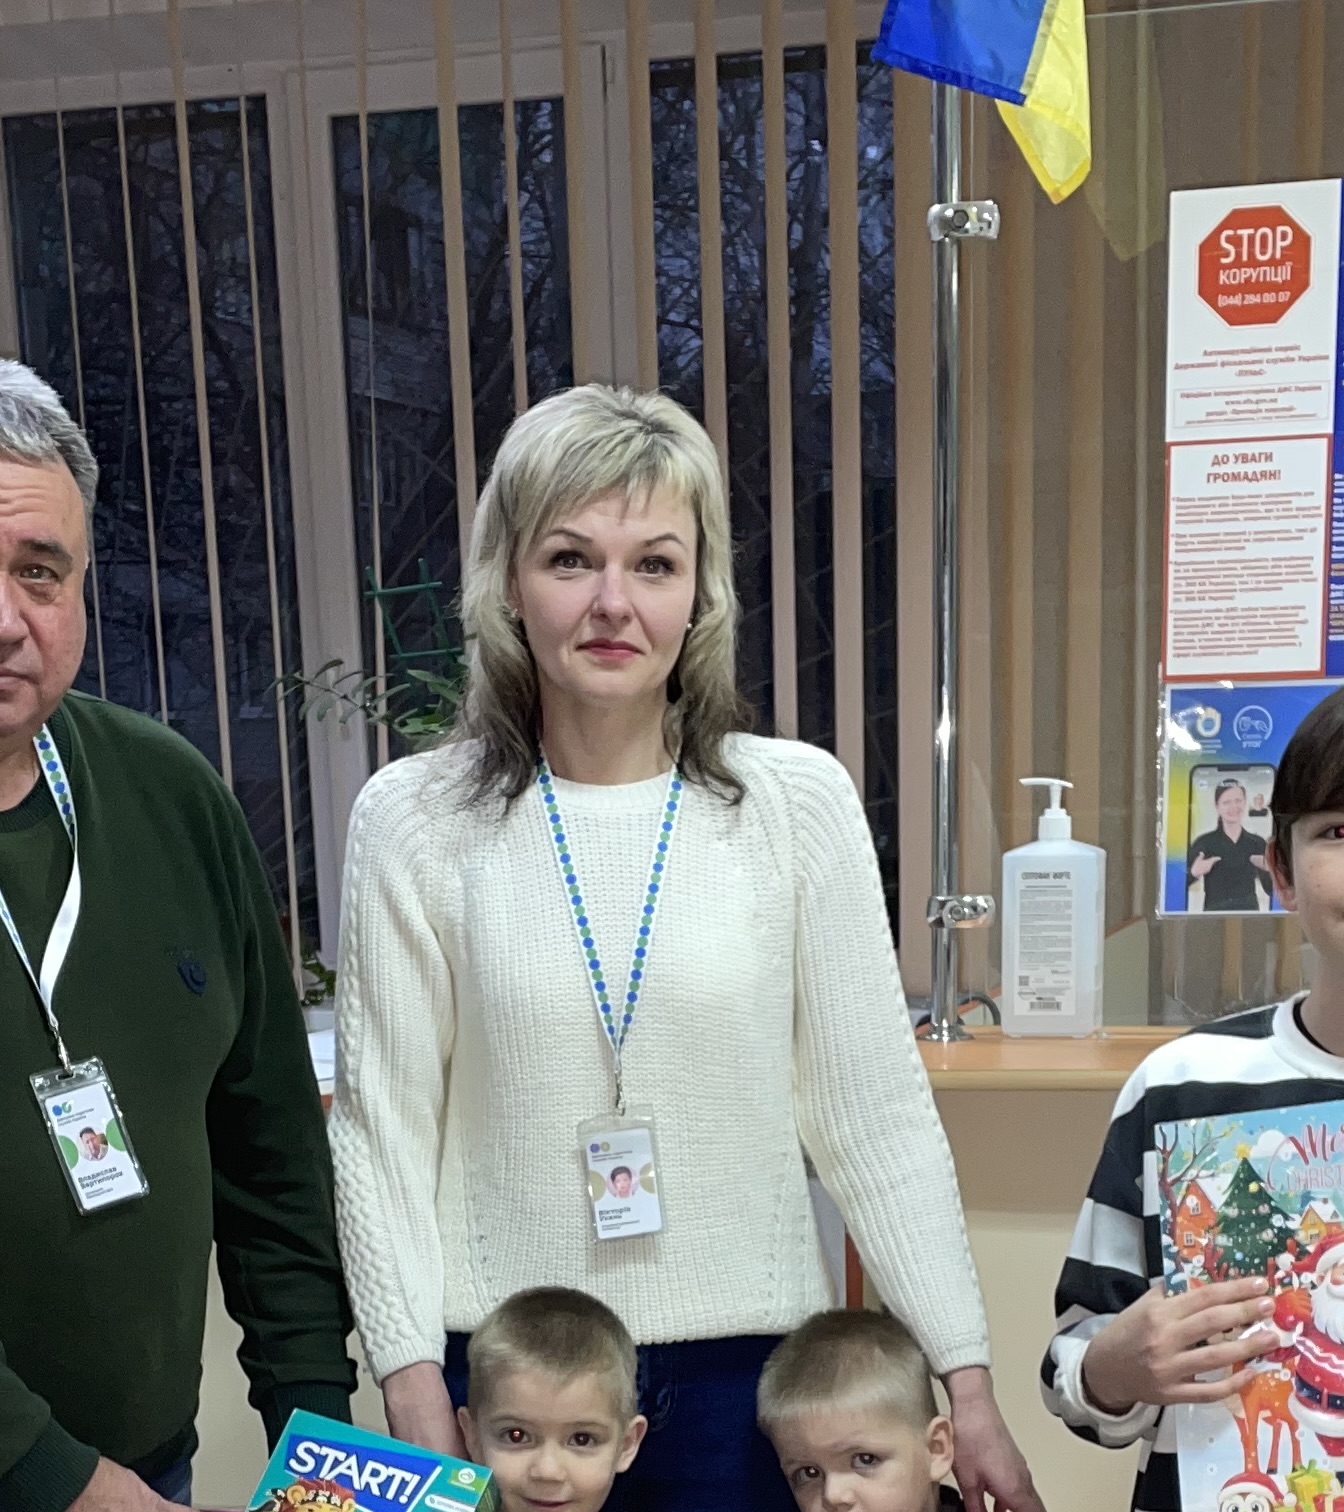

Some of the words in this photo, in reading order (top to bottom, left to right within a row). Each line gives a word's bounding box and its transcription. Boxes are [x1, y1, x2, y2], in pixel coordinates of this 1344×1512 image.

[1220, 226, 1293, 263] STOP
[1219, 261, 1293, 285] КОРУПЦІЇ
[1218, 292, 1242, 307] (044)
[1243, 293, 1261, 304] 284
[1262, 292, 1276, 303] 00
[1278, 291, 1291, 302] 07
[1211, 454, 1230, 467] ДО
[1233, 452, 1274, 465] УВАГИ
[1206, 470, 1281, 484] ГРОМАДЯН!
[289, 1441, 421, 1504] START!
